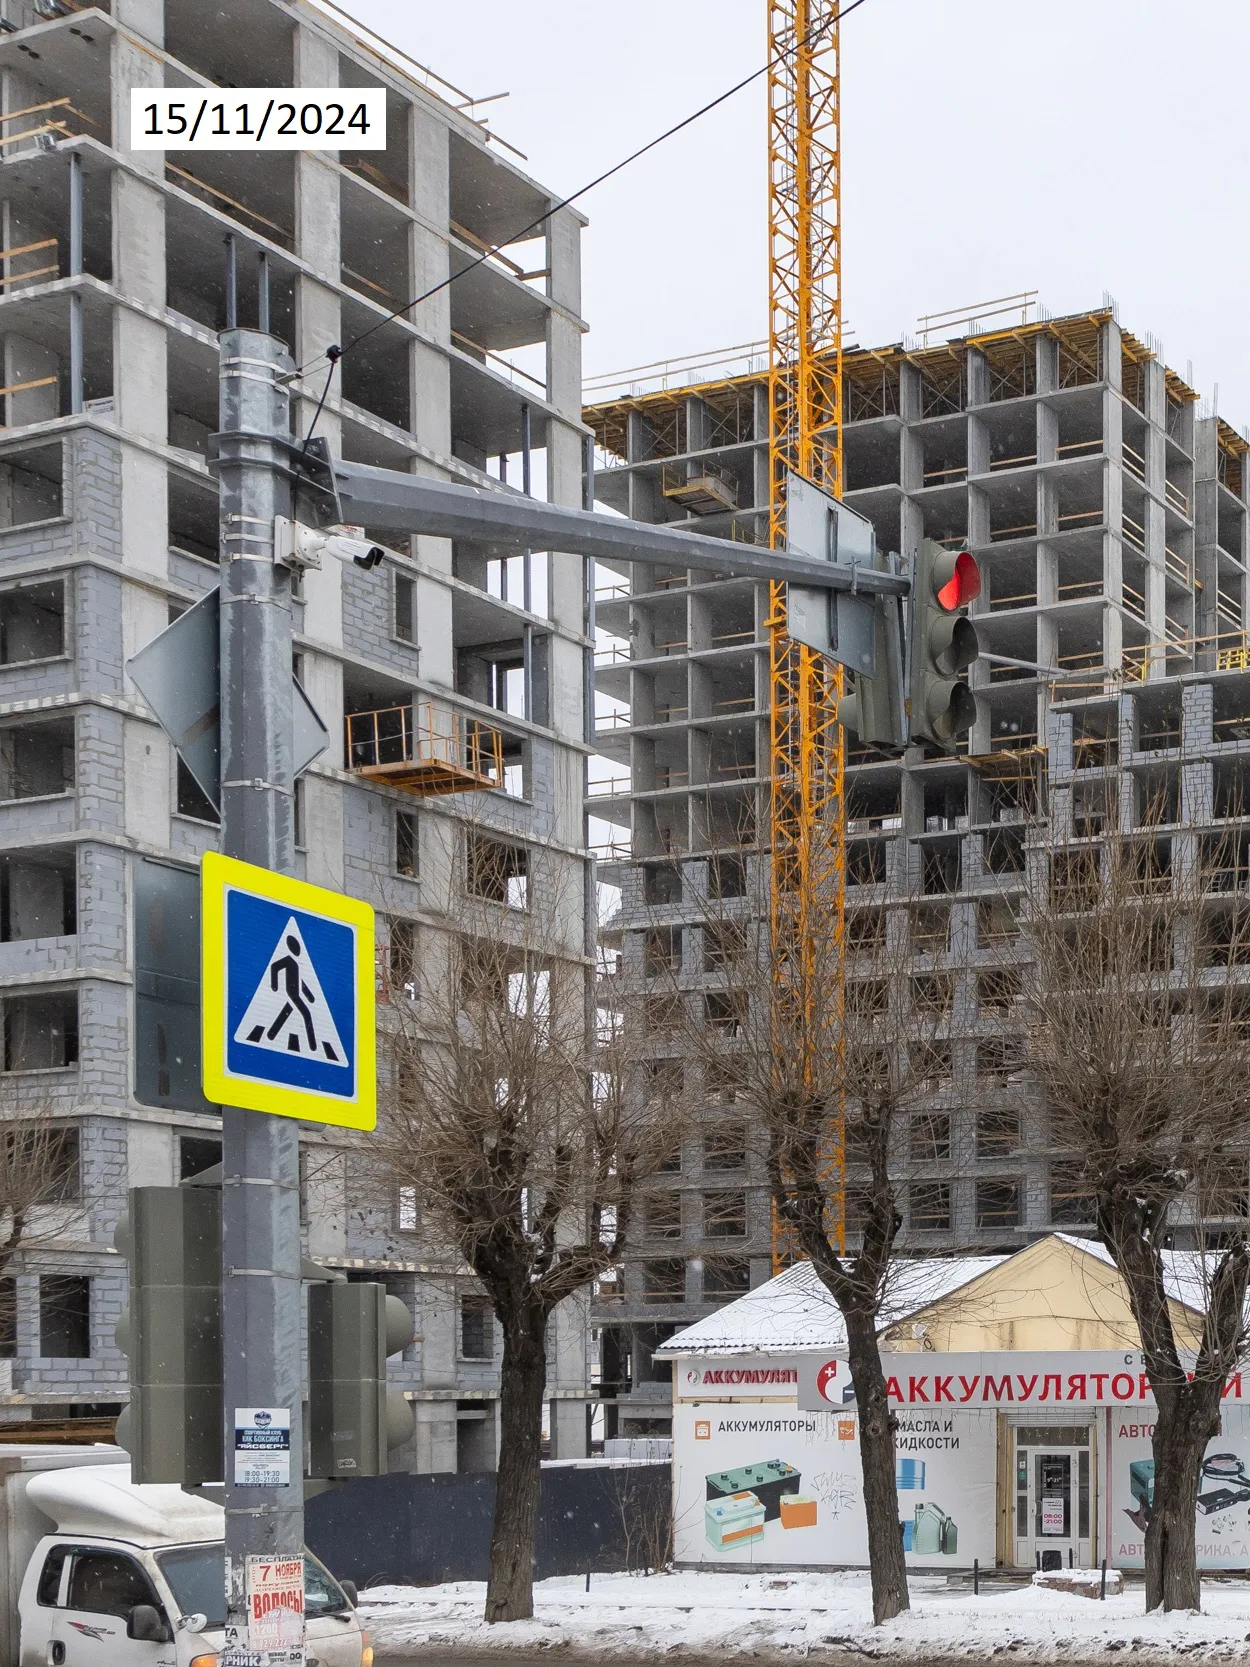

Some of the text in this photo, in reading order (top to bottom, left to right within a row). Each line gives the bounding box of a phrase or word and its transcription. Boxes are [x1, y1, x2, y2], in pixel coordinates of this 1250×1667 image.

[886, 1368, 1242, 1404] АККУМУЛЯТОРЙ
[718, 1420, 816, 1432] АККУМУЛЯТОРЫ
[897, 1420, 953, 1433] МАСЛА И
[251, 1555, 304, 1563] БЕСПЛАТН
[259, 1561, 302, 1581] 7 НОЯБРЯ
[253, 1590, 303, 1619] ВОЛОСЫ
